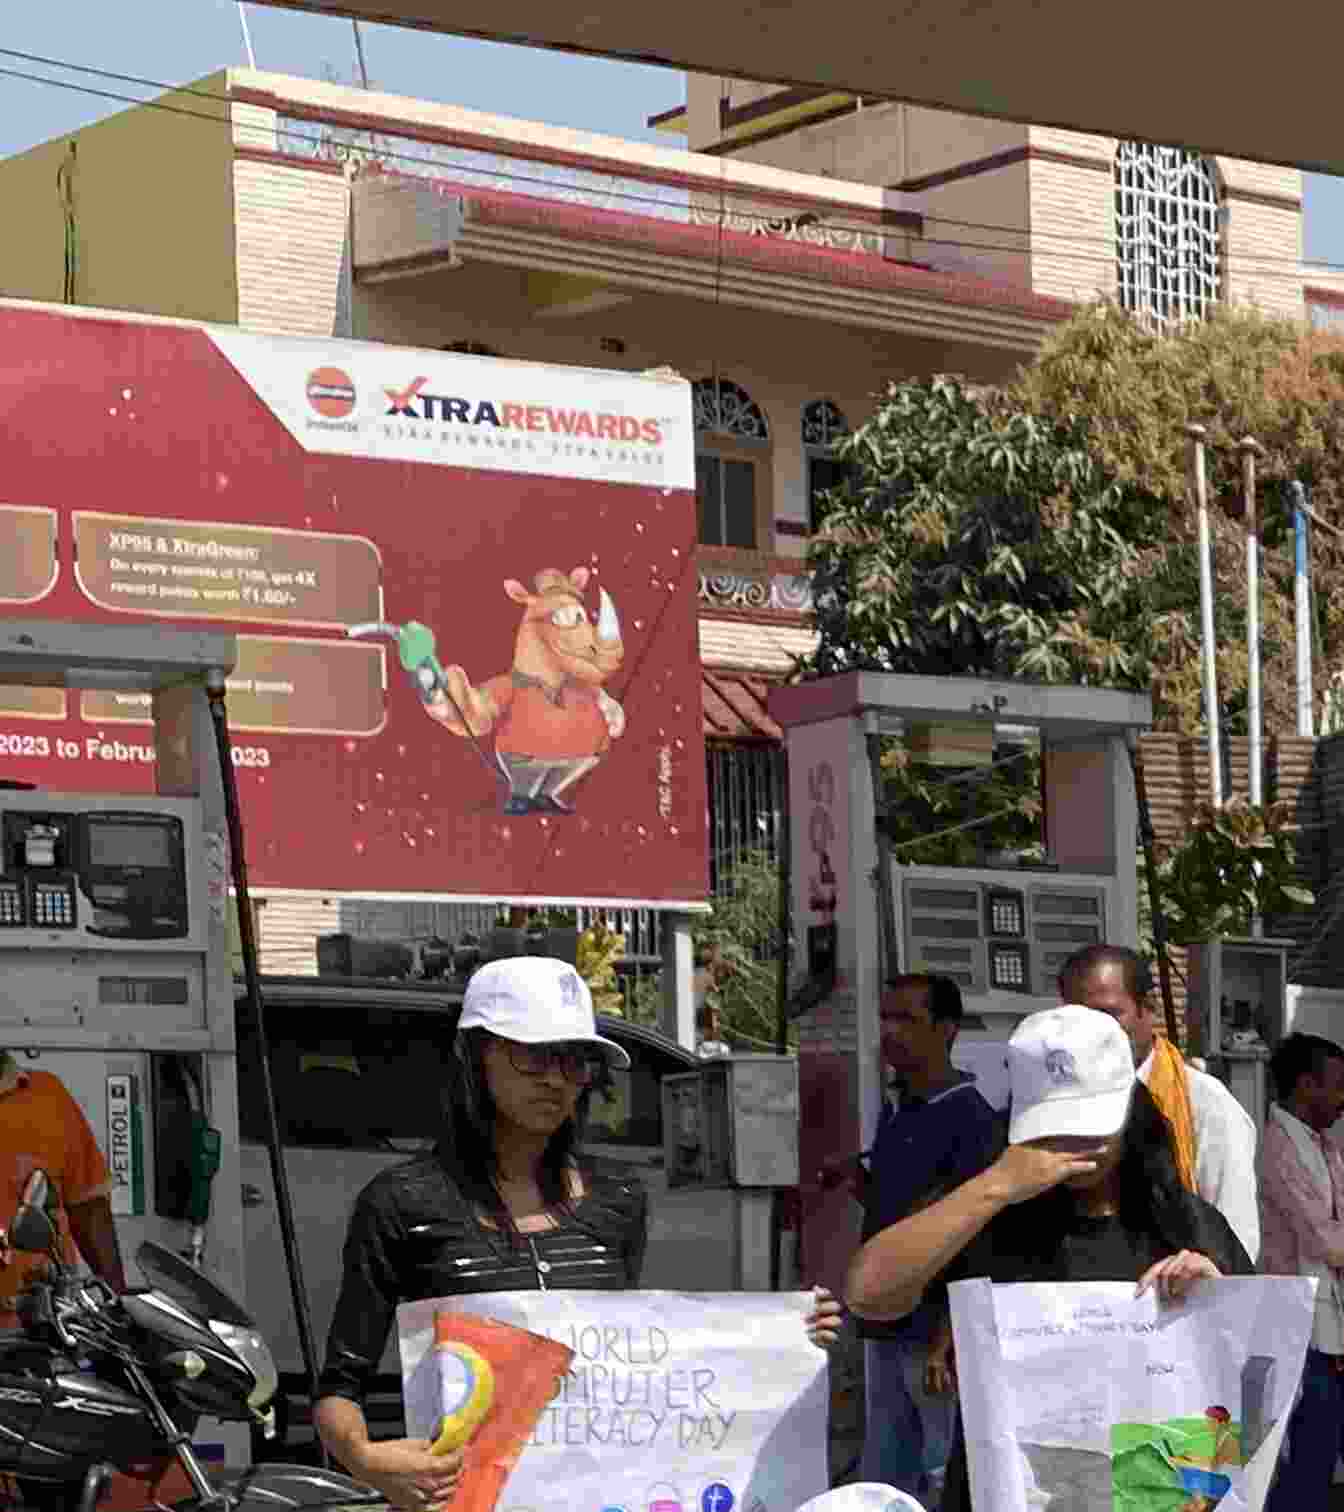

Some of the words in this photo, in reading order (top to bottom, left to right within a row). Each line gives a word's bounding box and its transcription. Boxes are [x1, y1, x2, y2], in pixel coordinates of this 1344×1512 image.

[295, 568, 317, 587] 4X
[56, 737, 80, 759] to
[86, 738, 157, 763] Febru
[230, 746, 271, 767] 023
[112, 1106, 129, 1186] PETROL
[553, 1364, 721, 1408] MPUTER
[524, 1406, 665, 1448] ITERACY
[679, 1409, 737, 1451] DAY
